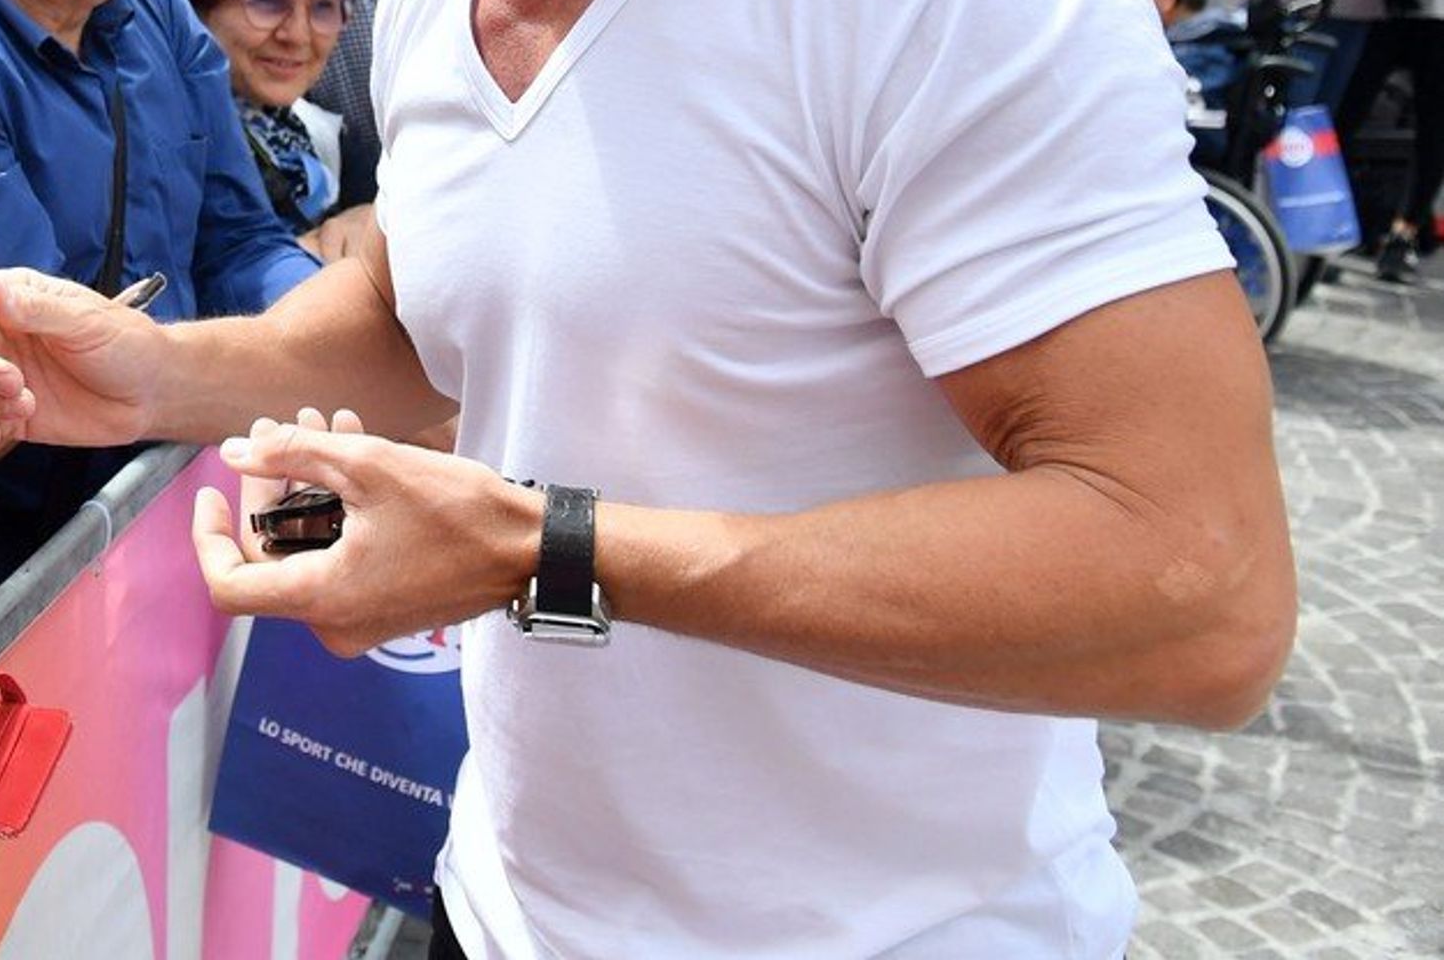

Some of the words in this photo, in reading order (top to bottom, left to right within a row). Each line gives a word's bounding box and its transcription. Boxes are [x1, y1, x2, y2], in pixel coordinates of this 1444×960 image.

[258, 716, 281, 738] LO
[281, 728, 333, 762] SPORT
[334, 751, 368, 777] CHE
[369, 764, 443, 807] DIVENTA
